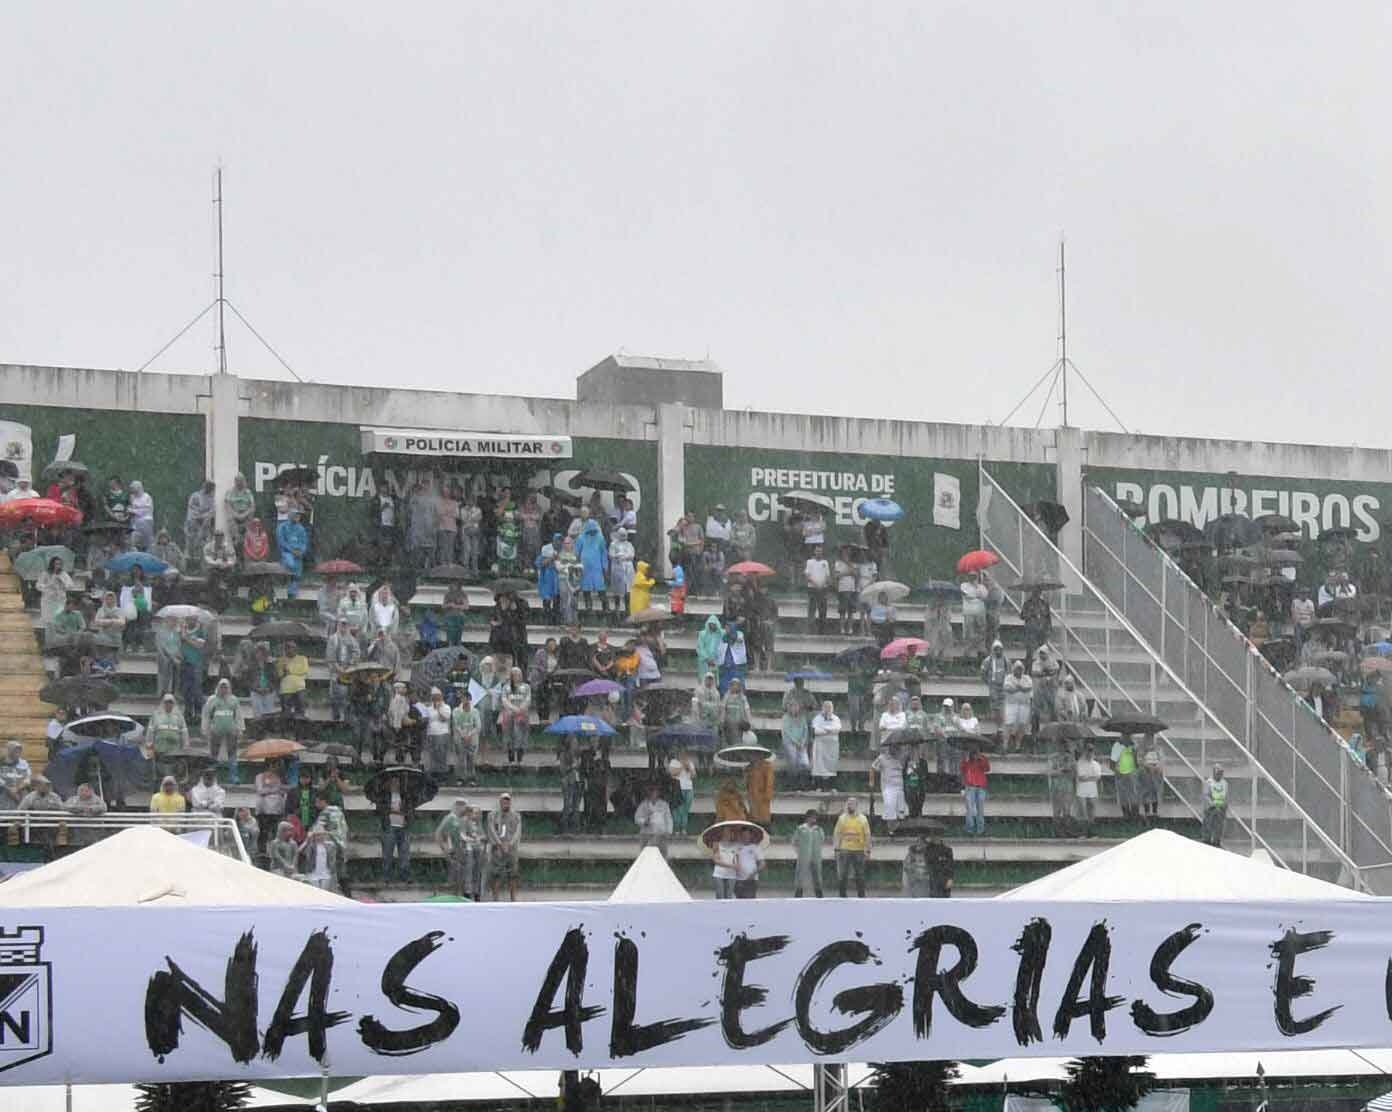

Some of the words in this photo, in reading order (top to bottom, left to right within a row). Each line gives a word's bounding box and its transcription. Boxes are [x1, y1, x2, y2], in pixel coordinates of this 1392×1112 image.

[405, 437, 472, 452] POLÍCIA
[477, 440, 543, 455] MILITAR
[255, 455, 377, 498] PÍCIA
[751, 467, 868, 492] PREFEITURA
[871, 475, 895, 493] DE
[748, 492, 896, 527] CHEC
[1116, 482, 1380, 543] BOMBEIROS
[145, 927, 460, 1066] NAS
[522, 917, 1214, 1060] ALEGRIAS
[1268, 924, 1343, 1037] E
